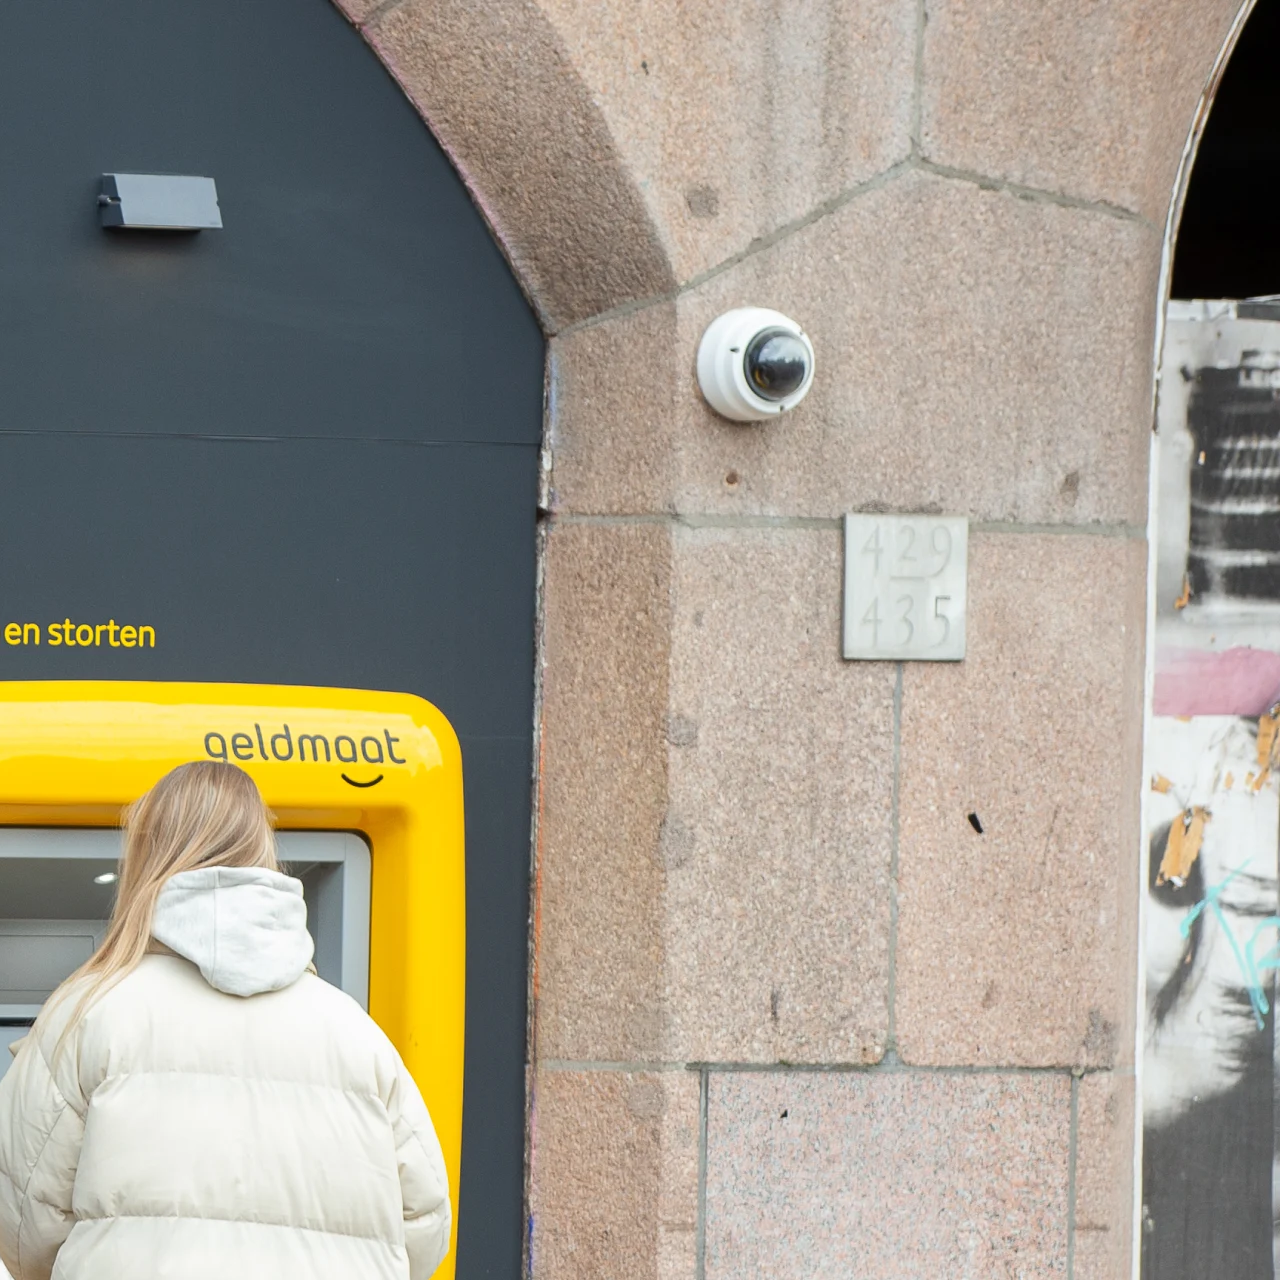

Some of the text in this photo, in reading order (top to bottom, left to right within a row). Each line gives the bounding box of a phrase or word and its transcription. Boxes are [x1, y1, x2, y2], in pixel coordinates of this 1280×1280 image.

[860, 523, 953, 578] 429
[4, 622, 40, 646] en
[48, 618, 156, 648] storten
[859, 593, 952, 651] 435
[204, 723, 407, 763] geldmaat
